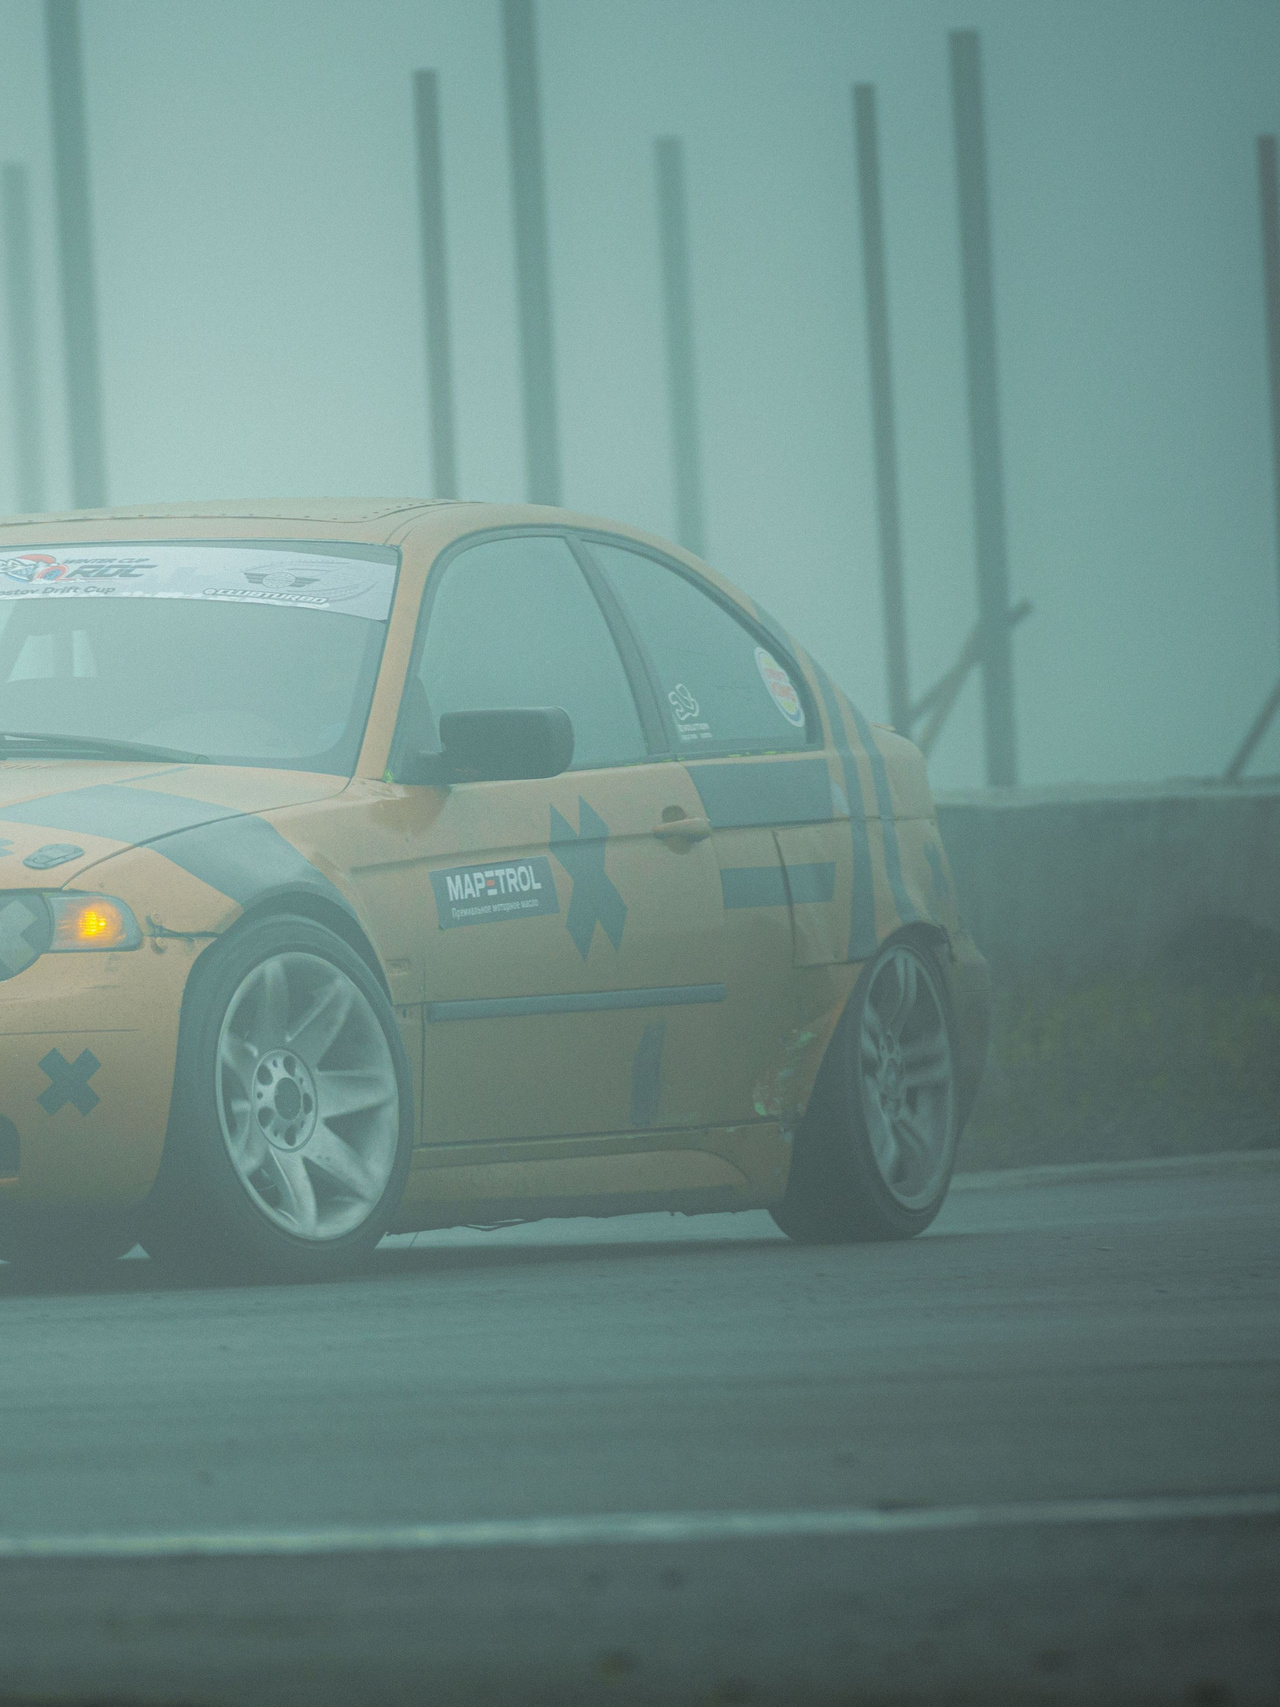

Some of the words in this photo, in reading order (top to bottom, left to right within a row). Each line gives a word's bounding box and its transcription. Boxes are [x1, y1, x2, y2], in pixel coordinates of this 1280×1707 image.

[42, 586, 79, 595] Drift
[83, 585, 116, 595] Cup
[446, 865, 542, 902] MAPETROL
[451, 904, 492, 920] Премиальное
[492, 901, 521, 914] моторное
